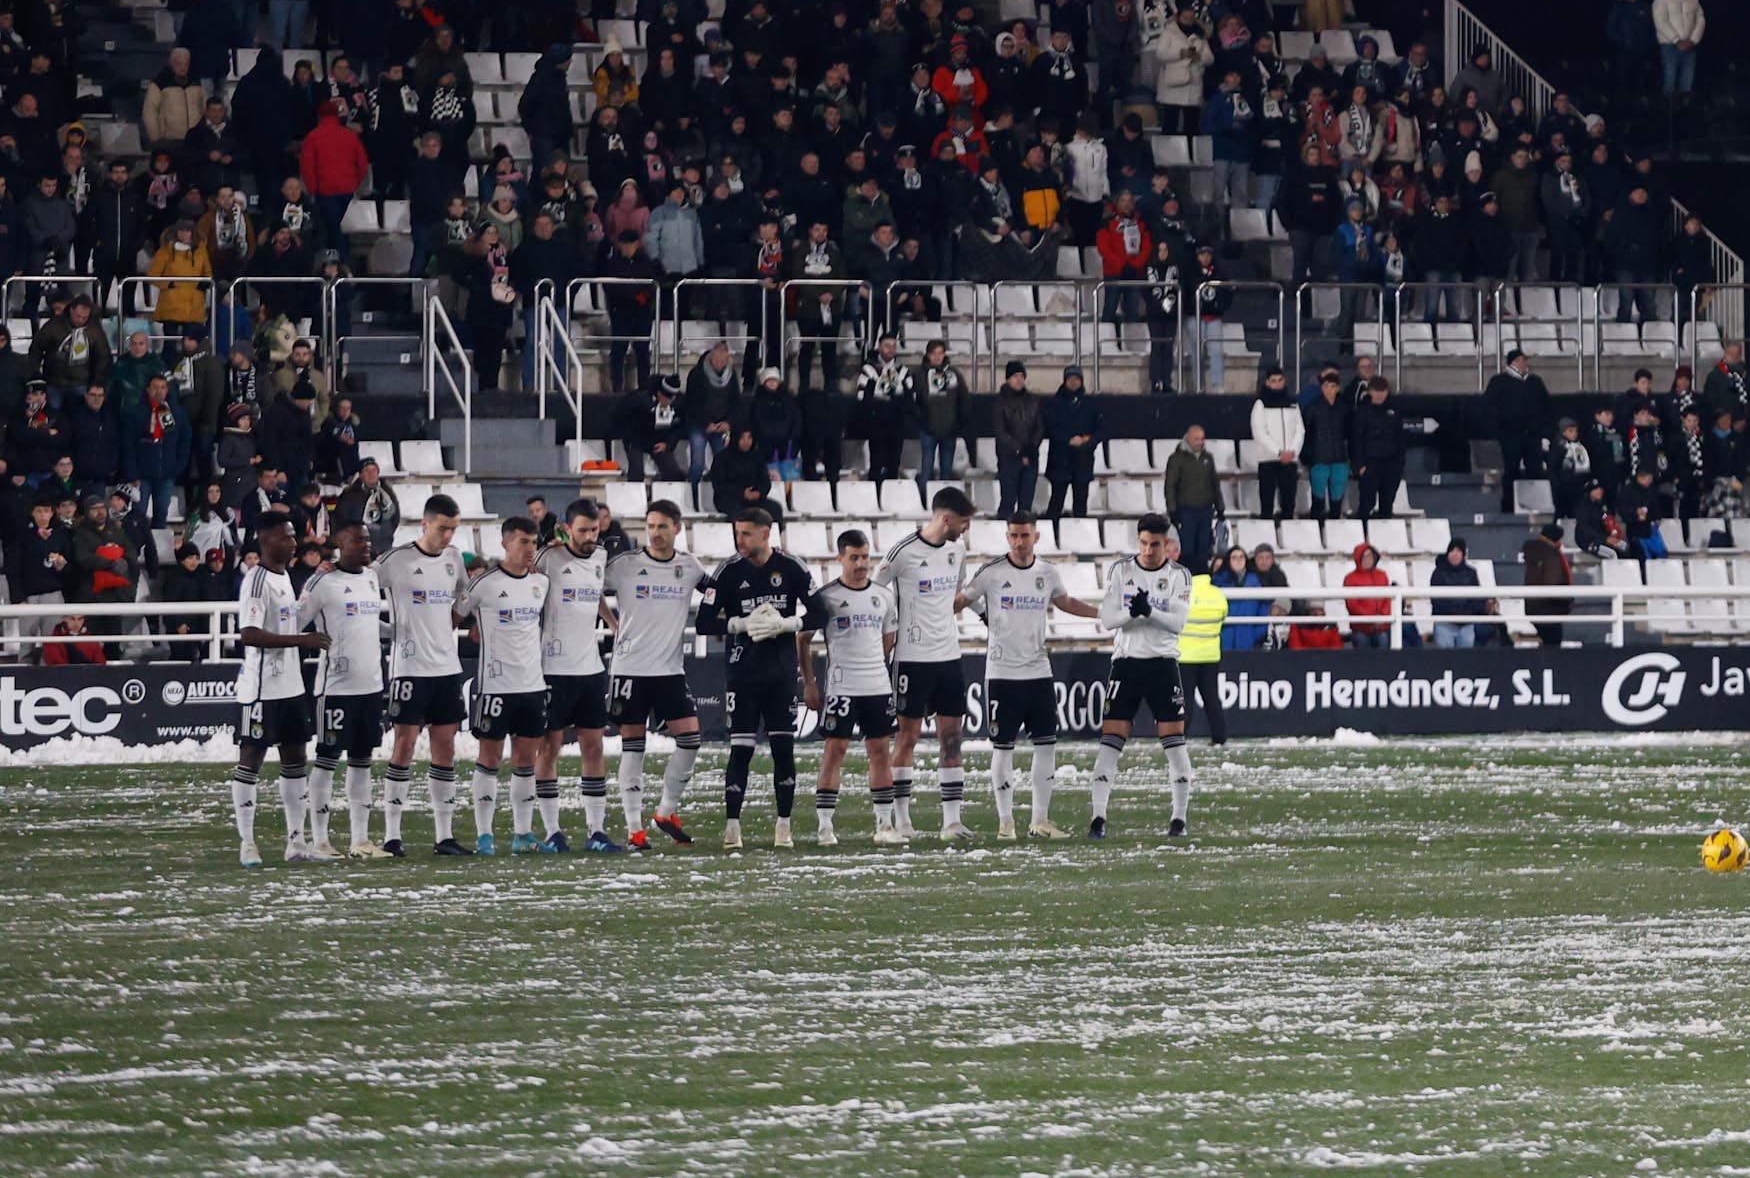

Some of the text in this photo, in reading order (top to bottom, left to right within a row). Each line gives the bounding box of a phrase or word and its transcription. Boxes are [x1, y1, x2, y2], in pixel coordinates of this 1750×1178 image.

[652, 585, 685, 595] REALE
[1016, 596, 1046, 605] REALE
[393, 680, 414, 702] 18
[613, 677, 633, 700] 14
[898, 674, 909, 695] 9
[1106, 679, 1121, 700] 11
[1217, 668, 1572, 713] bino Hernández, S.L.
[250, 702, 263, 722] 4
[482, 696, 504, 718] 16
[827, 696, 851, 717] 23
[989, 699, 1000, 721] 7
[156, 723, 236, 737] www.resyte
[325, 708, 345, 731] 12
